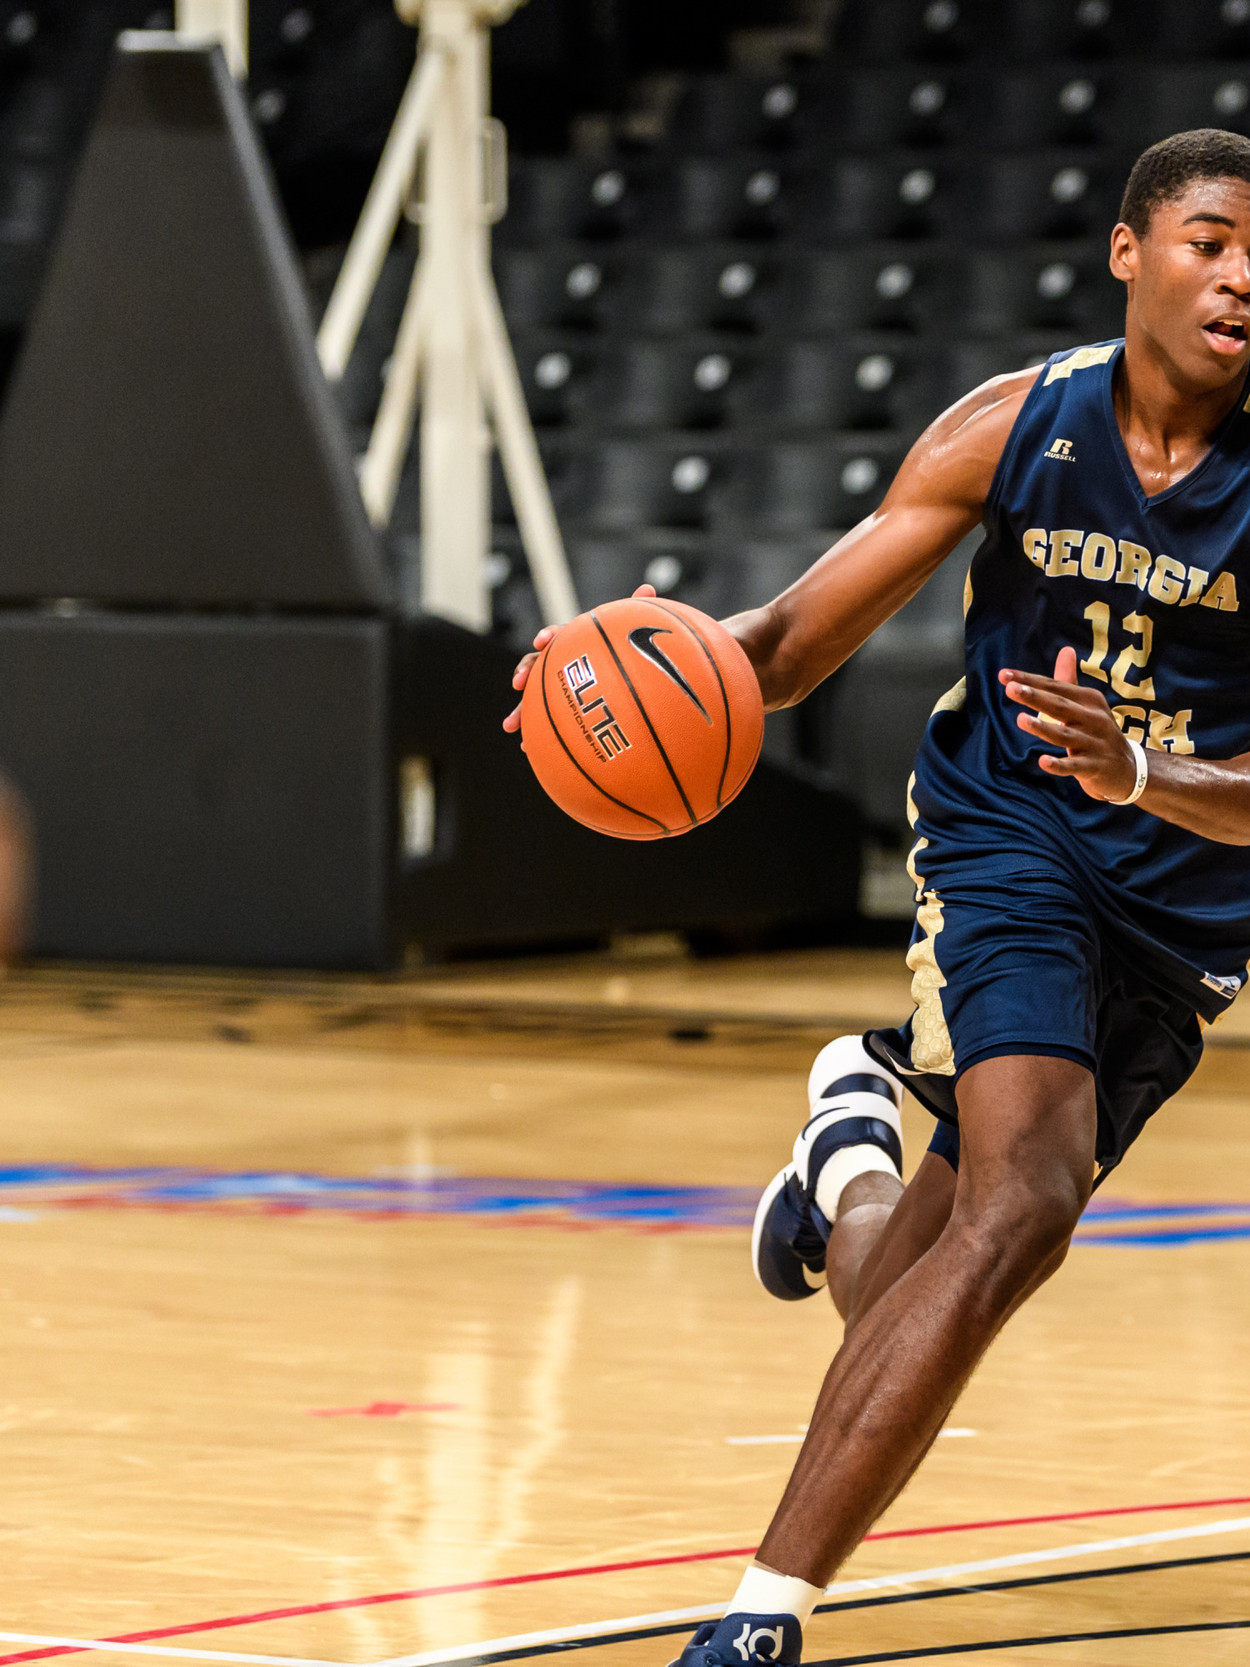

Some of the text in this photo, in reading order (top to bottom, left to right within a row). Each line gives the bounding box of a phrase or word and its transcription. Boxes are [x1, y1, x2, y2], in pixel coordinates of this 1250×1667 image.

[1044, 451, 1076, 462] RUSSELL
[1022, 528, 1240, 612] GEORGIA
[1080, 600, 1156, 701] 12
[557, 669, 607, 763] CHAMPIONSHIP
[563, 653, 633, 761] ELITE
